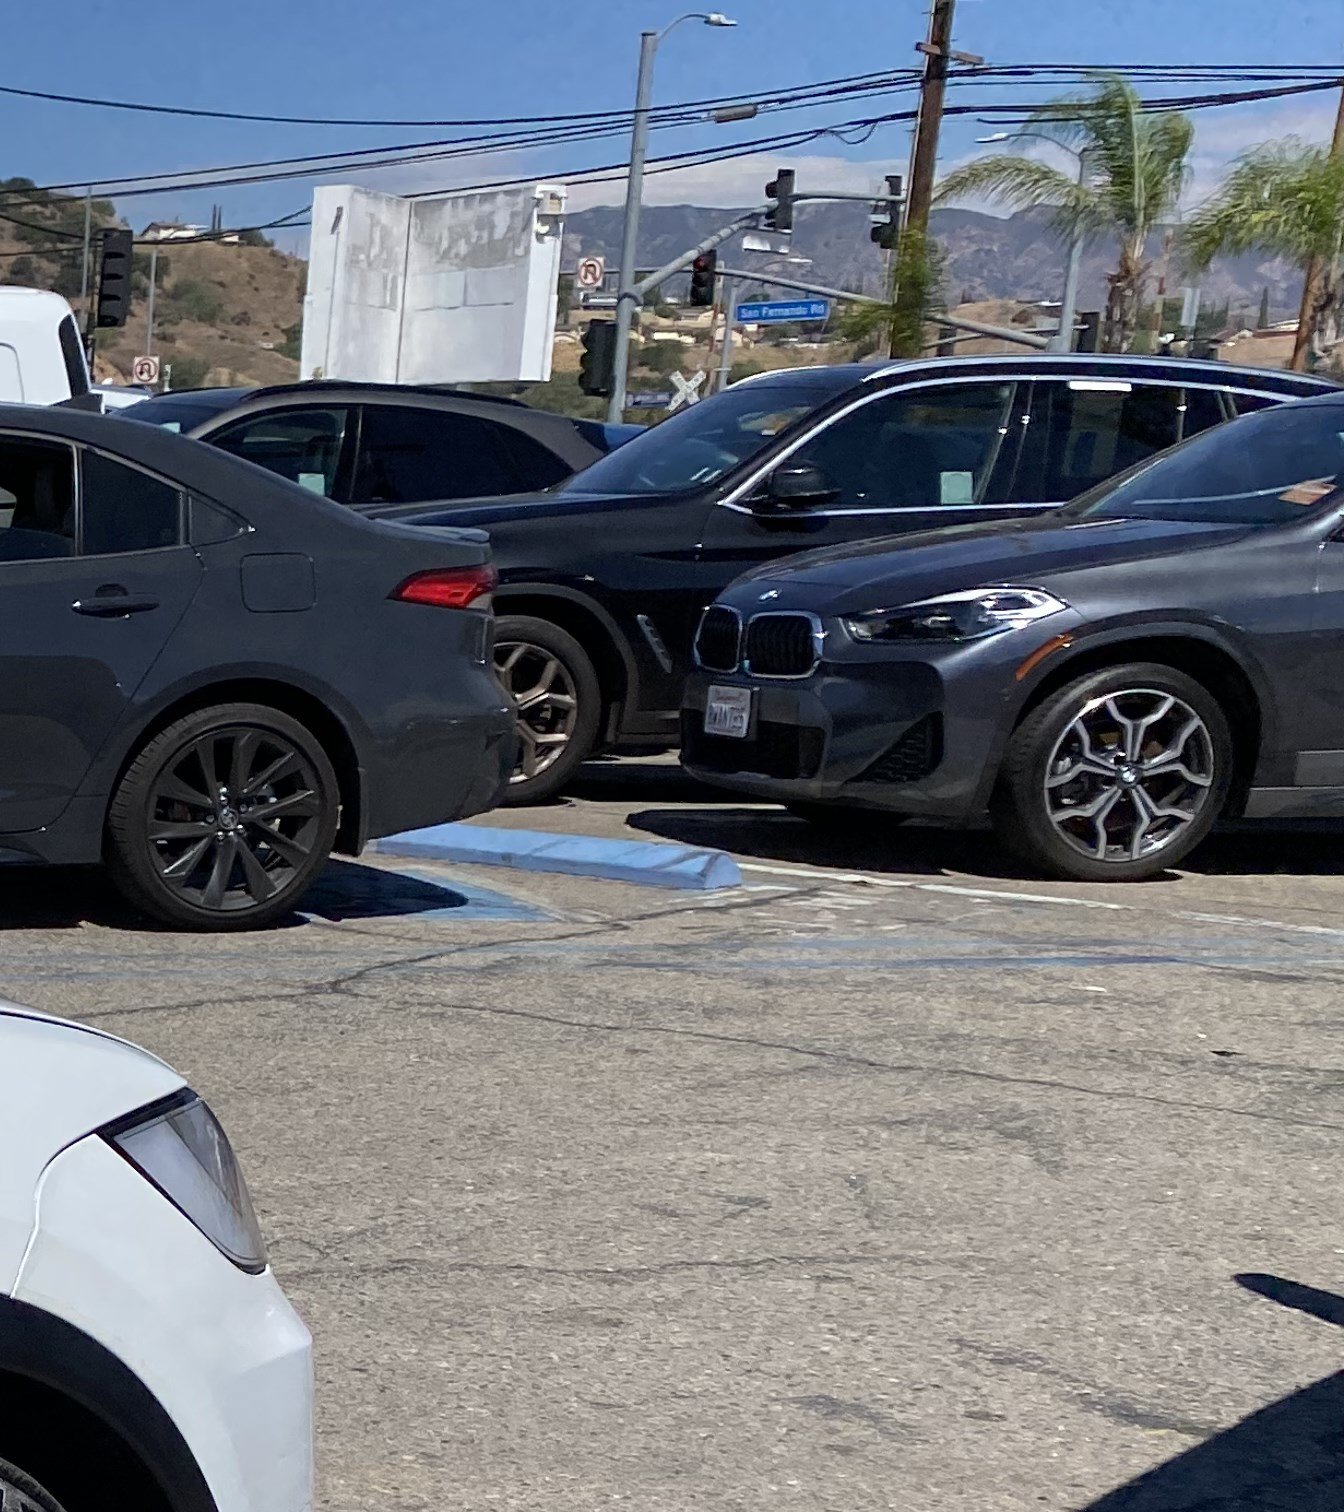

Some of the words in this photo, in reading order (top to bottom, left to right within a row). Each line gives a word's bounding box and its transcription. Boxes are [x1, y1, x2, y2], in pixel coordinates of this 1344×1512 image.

[741, 308, 759, 318] San
[762, 305, 808, 317] Fernando
[811, 304, 825, 314] Rd
